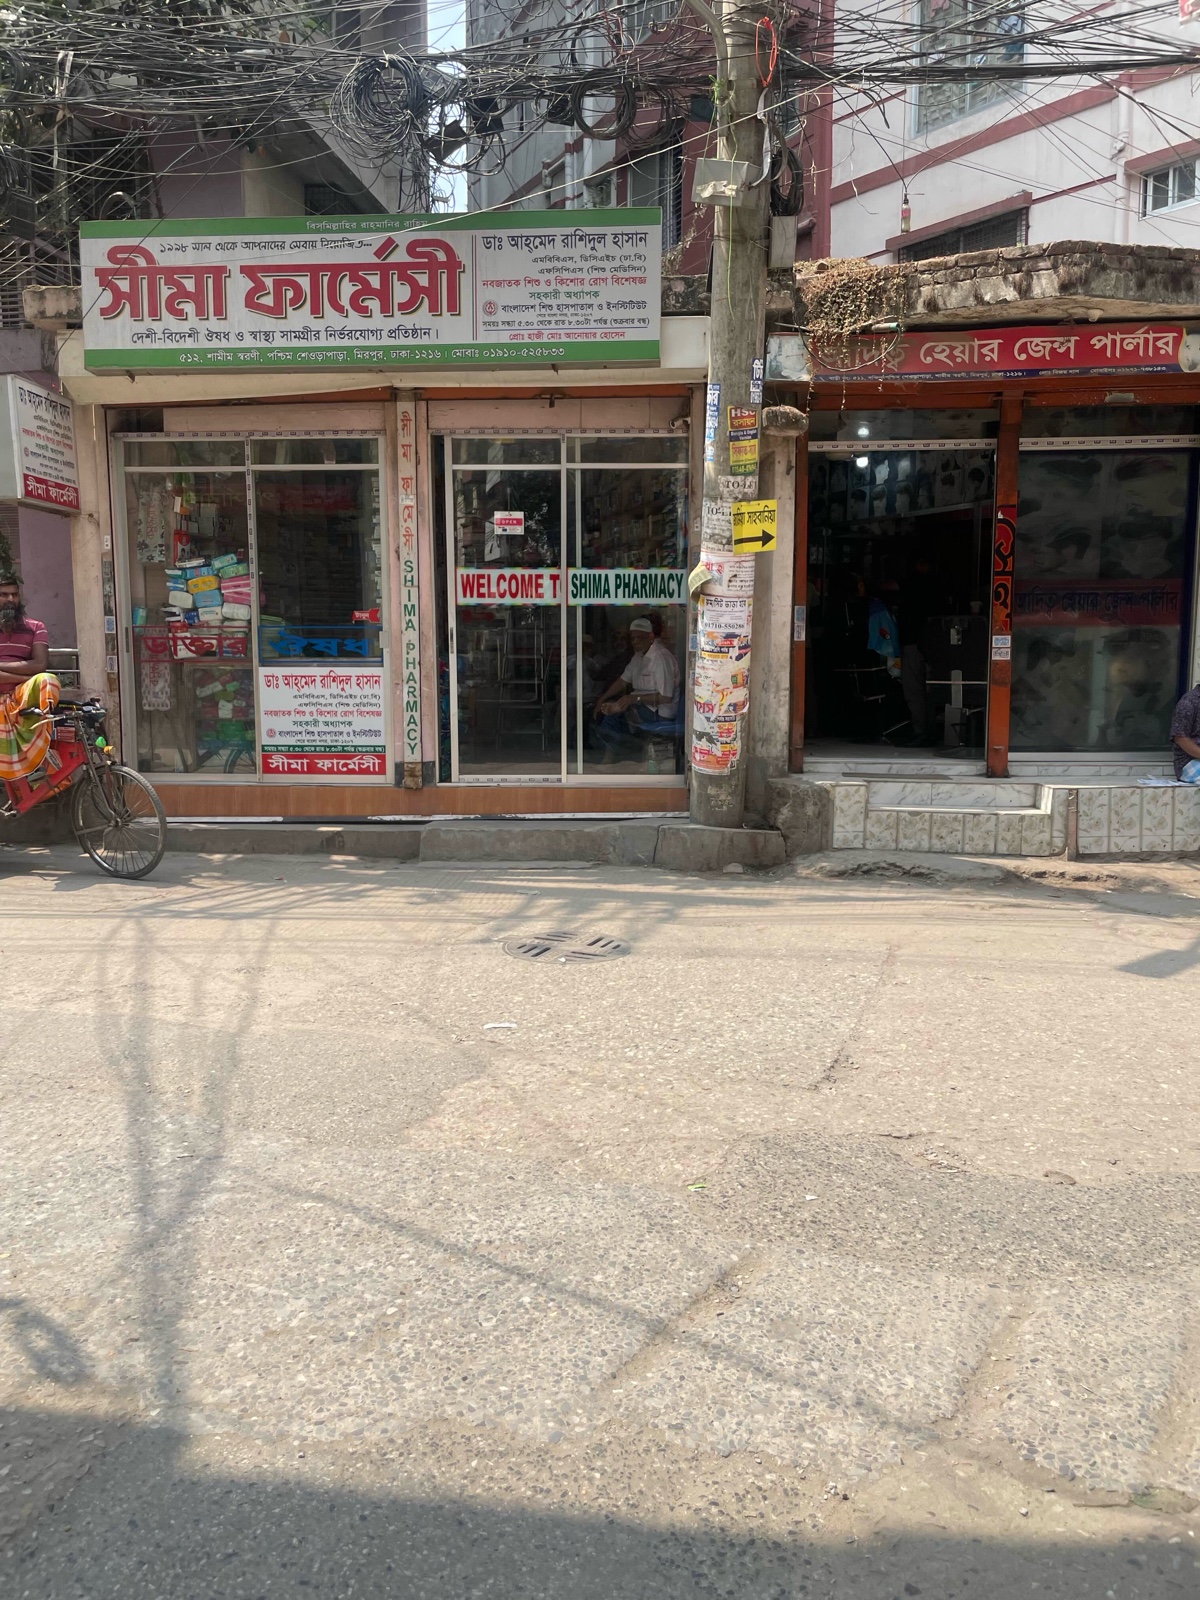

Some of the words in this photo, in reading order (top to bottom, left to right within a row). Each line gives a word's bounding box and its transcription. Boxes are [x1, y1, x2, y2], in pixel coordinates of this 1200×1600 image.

[160, 242, 188, 253] ১৯৯৮
[191, 241, 212, 252] সাল
[215, 240, 238, 252] থেকে
[241, 239, 286, 251] আপনাদের
[289, 239, 317, 250] সেবায়
[482, 234, 503, 250] ডাঃ
[561, 228, 607, 252] রাশিদুল
[611, 231, 649, 249] হাসান
[95, 244, 229, 321] সীমা
[240, 236, 463, 319] ফার্মেসী
[482, 278, 520, 289] নবজাতক
[524, 276, 541, 288] শিশু
[546, 278, 552, 287] ও
[555, 275, 585, 288] কিশোর
[589, 275, 608, 286] রোগ
[611, 274, 647, 286] বিশেষজ্ঞ
[529, 289, 560, 300] সহকারী
[501, 303, 536, 314] বাংলাদেশ
[539, 301, 554, 312] শিশু
[556, 301, 594, 312] হাসপাতাল
[598, 302, 603, 310] ও
[606, 300, 647, 311] ইনস্টিটিউট
[131, 328, 200, 344] দেশী-বিদেশী
[204, 327, 231, 342] ঔষধ
[234, 331, 245, 342] ও
[248, 329, 275, 345] স্বাস্থ্য
[280, 325, 320, 342] সামগ্রীর
[325, 325, 383, 342] নির্ভরযোগ্য
[387, 324, 432, 341] প্রতিষ্ঠান
[528, 330, 544, 340] হাজী
[565, 330, 597, 340] আনোয়ার
[599, 329, 626, 340] হোসেন
[179, 352, 203, 363] ৫১২,
[206, 349, 233, 362] শামীম
[267, 349, 293, 361] পশ্চিম
[296, 348, 350, 362] শেওড়াপাড়া,
[353, 347, 387, 361] মিরপুর,
[390, 348, 442, 360] ঢাকা-১২১৬
[919, 337, 1003, 367] হেয়ার
[1090, 325, 1178, 358] পার্লার
[27, 476, 47, 498] সীমা
[403, 559, 416, 632] SHIMA
[460, 573, 544, 599] WELCOME
[549, 573, 561, 598] T
[571, 572, 609, 599] SHIMA
[615, 572, 684, 599] PHARMACY
[268, 629, 370, 657] ঔষধ
[264, 673, 279, 689] ডাঃ
[320, 669, 352, 693] রাশিদুল
[355, 673, 381, 690] হাসান
[405, 640, 418, 756] PHARMACY
[264, 709, 292, 718] নবজাতক
[294, 708, 306, 717] শিশু
[309, 709, 314, 717] ও
[316, 708, 338, 718] কিশোর
[340, 708, 354, 717] রোগ
[292, 718, 320, 729] সহকারী
[322, 719, 353, 728] অধ্যাপক
[278, 730, 303, 739] বাংলাদেশ
[304, 729, 315, 738] শিশু
[317, 729, 343, 738] হাসপাতাল
[346, 730, 351, 738] ও
[267, 754, 309, 772] সীমা
[314, 754, 381, 772] ফার্মেসী
